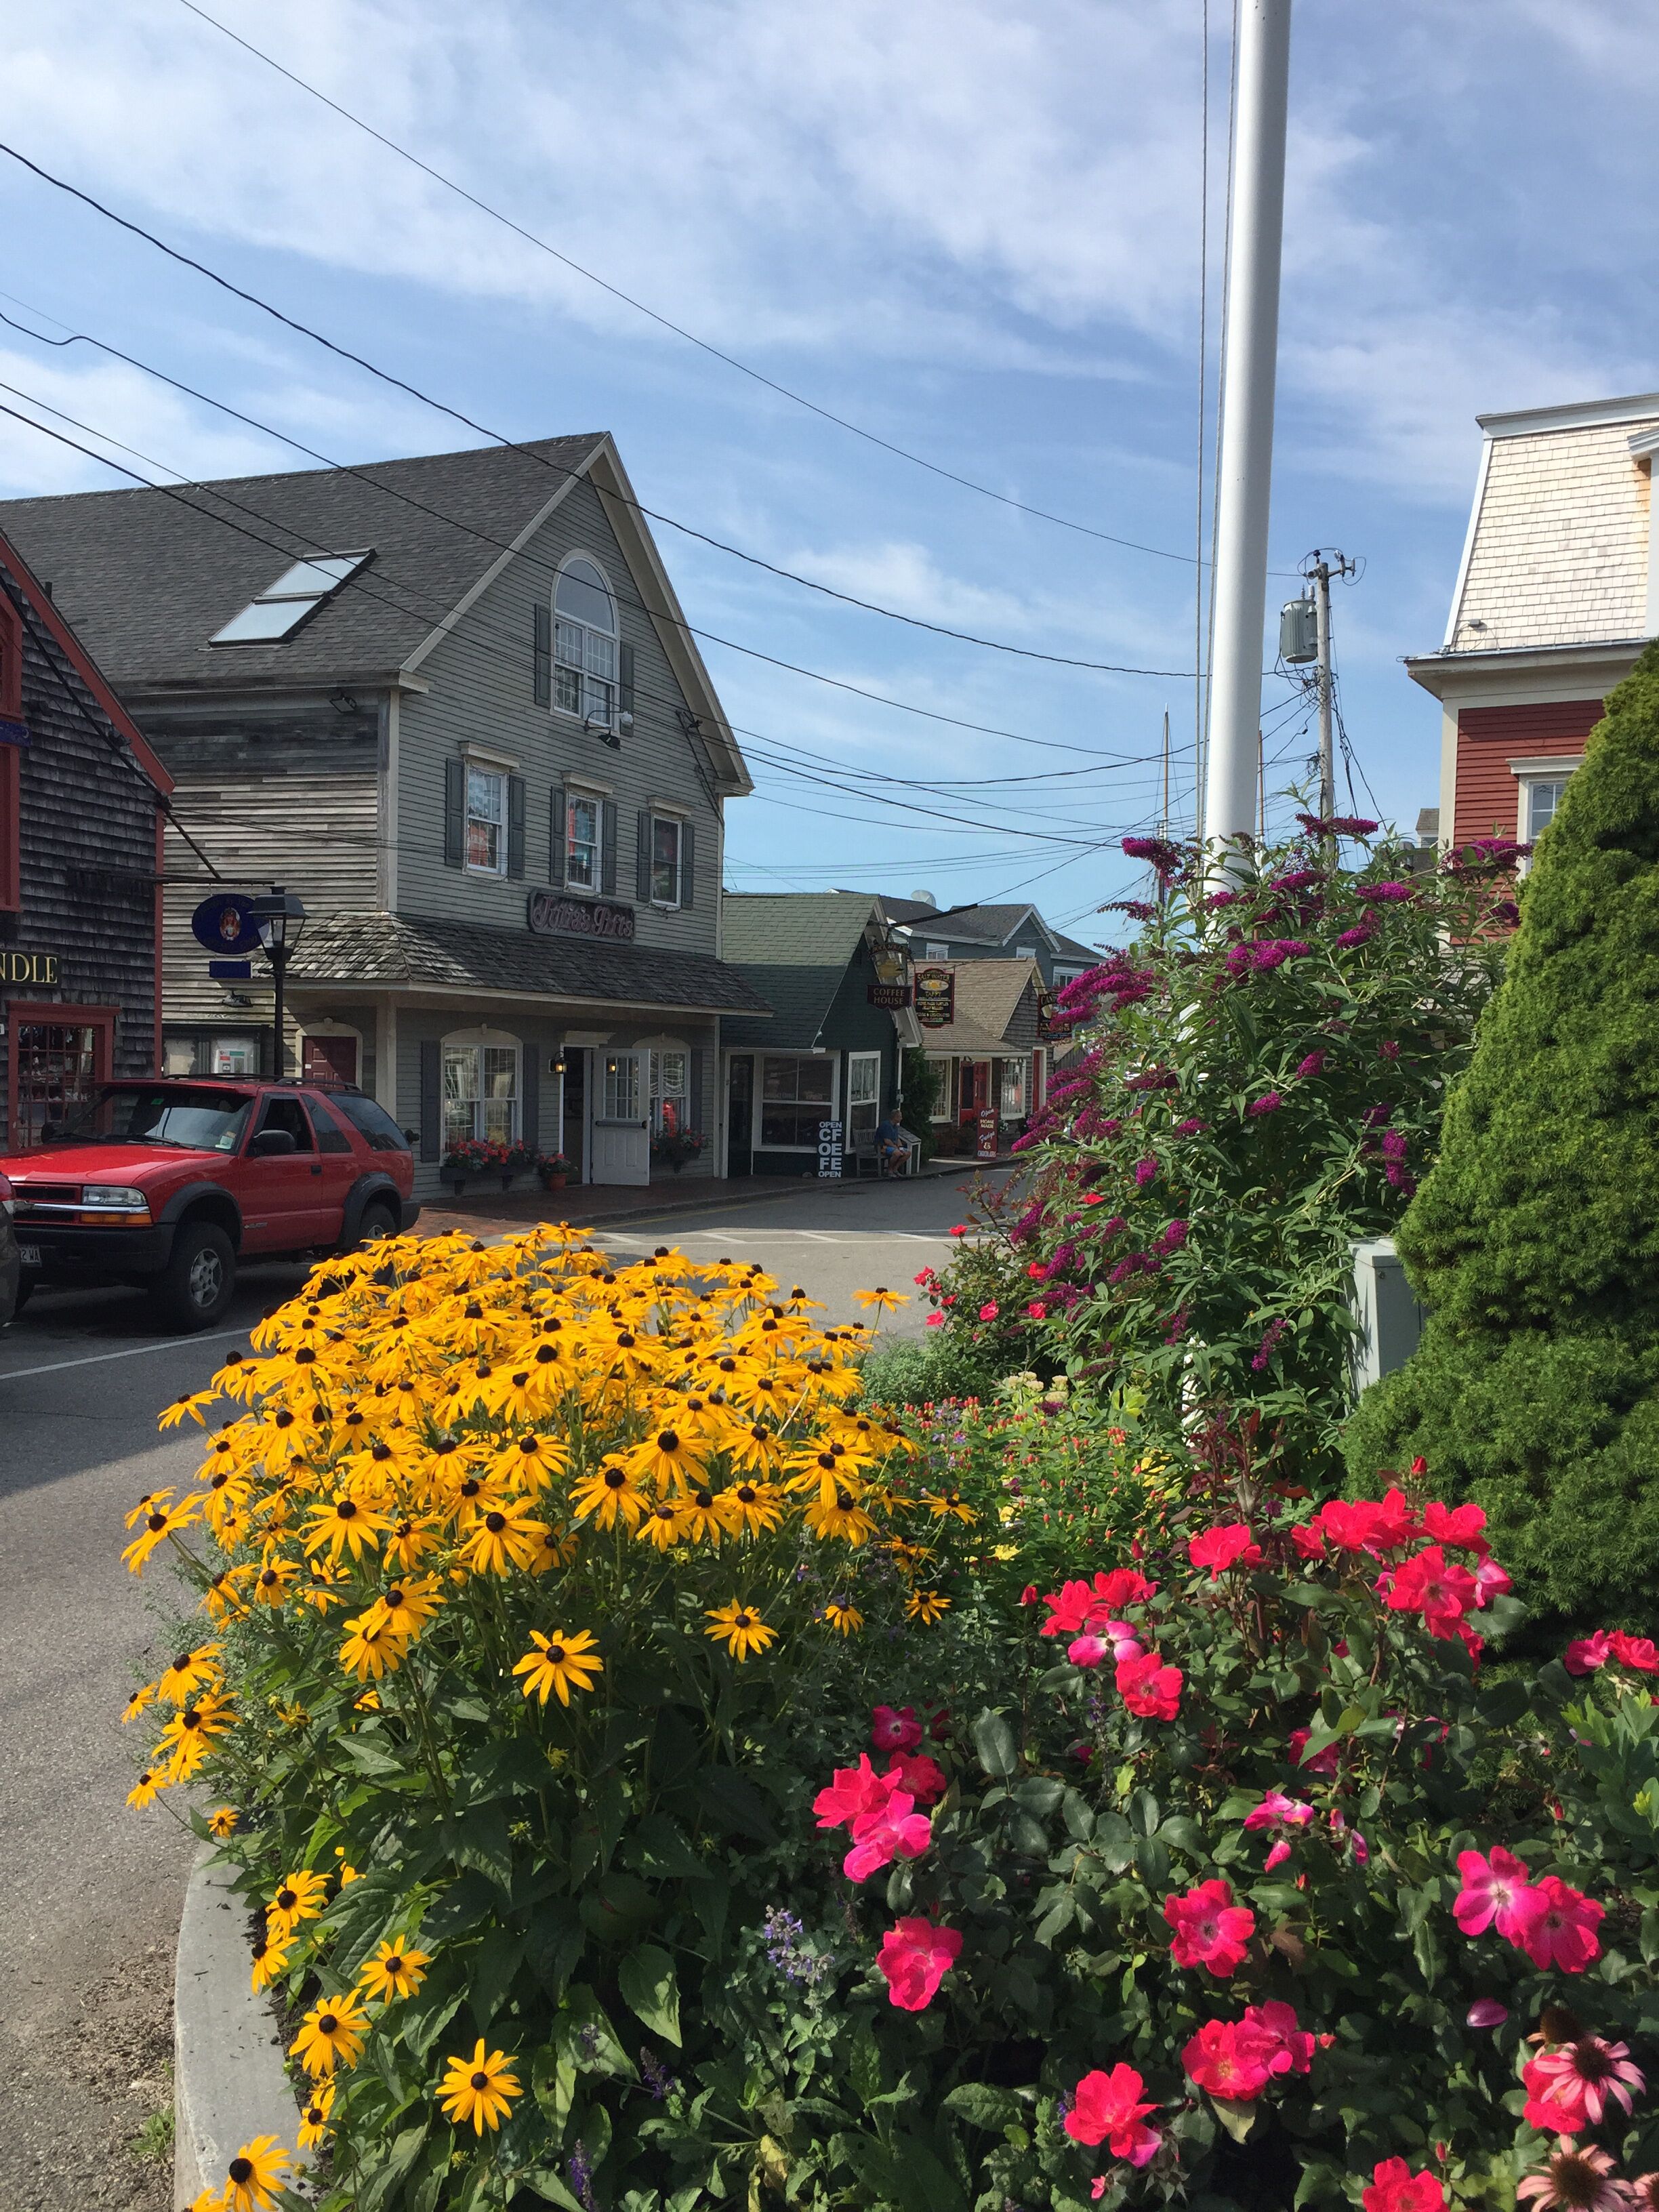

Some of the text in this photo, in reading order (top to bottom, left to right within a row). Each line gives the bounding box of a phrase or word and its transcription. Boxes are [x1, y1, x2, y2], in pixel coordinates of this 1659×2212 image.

[931, 974, 950, 983] WATER
[873, 987, 905, 997] COFFEE
[874, 996, 904, 1005] HOUSE
[981, 1108, 994, 1118] Open
[819, 1121, 842, 1129] OPEN
